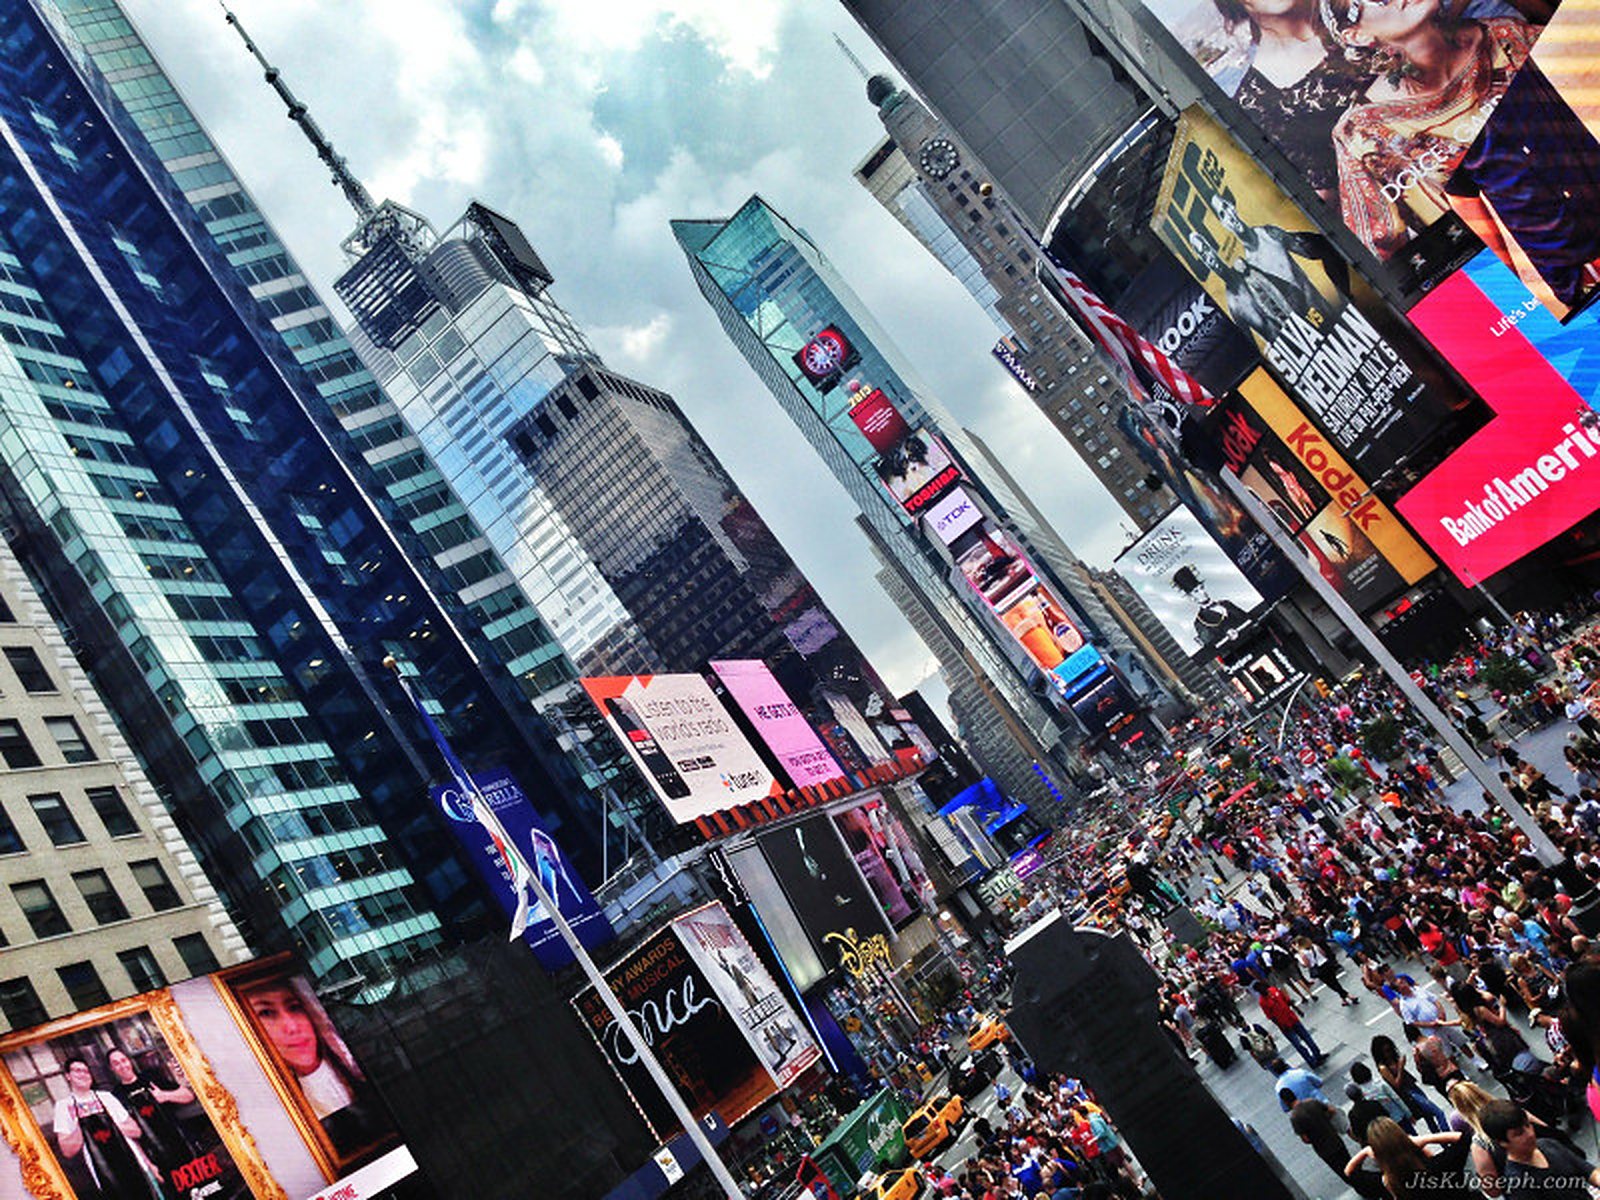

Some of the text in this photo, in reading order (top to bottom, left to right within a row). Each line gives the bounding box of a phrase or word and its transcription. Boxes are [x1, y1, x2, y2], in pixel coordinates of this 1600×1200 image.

[1380, 144, 1448, 203] DOLCE
[1264, 311, 1324, 385] SILVA
[1490, 309, 1527, 337] Life's
[1293, 302, 1381, 415] WEIDMAN
[848, 385, 872, 406] 2013
[1321, 377, 1367, 434] SATURDAY
[1356, 348, 1388, 388] JULY
[1378, 340, 1399, 362] 6
[1336, 423, 1358, 448] LIVE
[1349, 414, 1367, 433] ON
[904, 466, 959, 511] TOSHIBA
[1286, 421, 1382, 531] Kodak
[943, 501, 971, 523] TDK
[1440, 500, 1497, 547] Bank
[1483, 482, 1512, 522] of
[1137, 525, 1182, 566] DRUNK
[633, 699, 681, 718] Listen
[591, 952, 685, 1029] BET MUSICAL
[592, 976, 625, 1004] TNY
[622, 937, 676, 982] AWARDS
[171, 1152, 223, 1192] DEXTER
